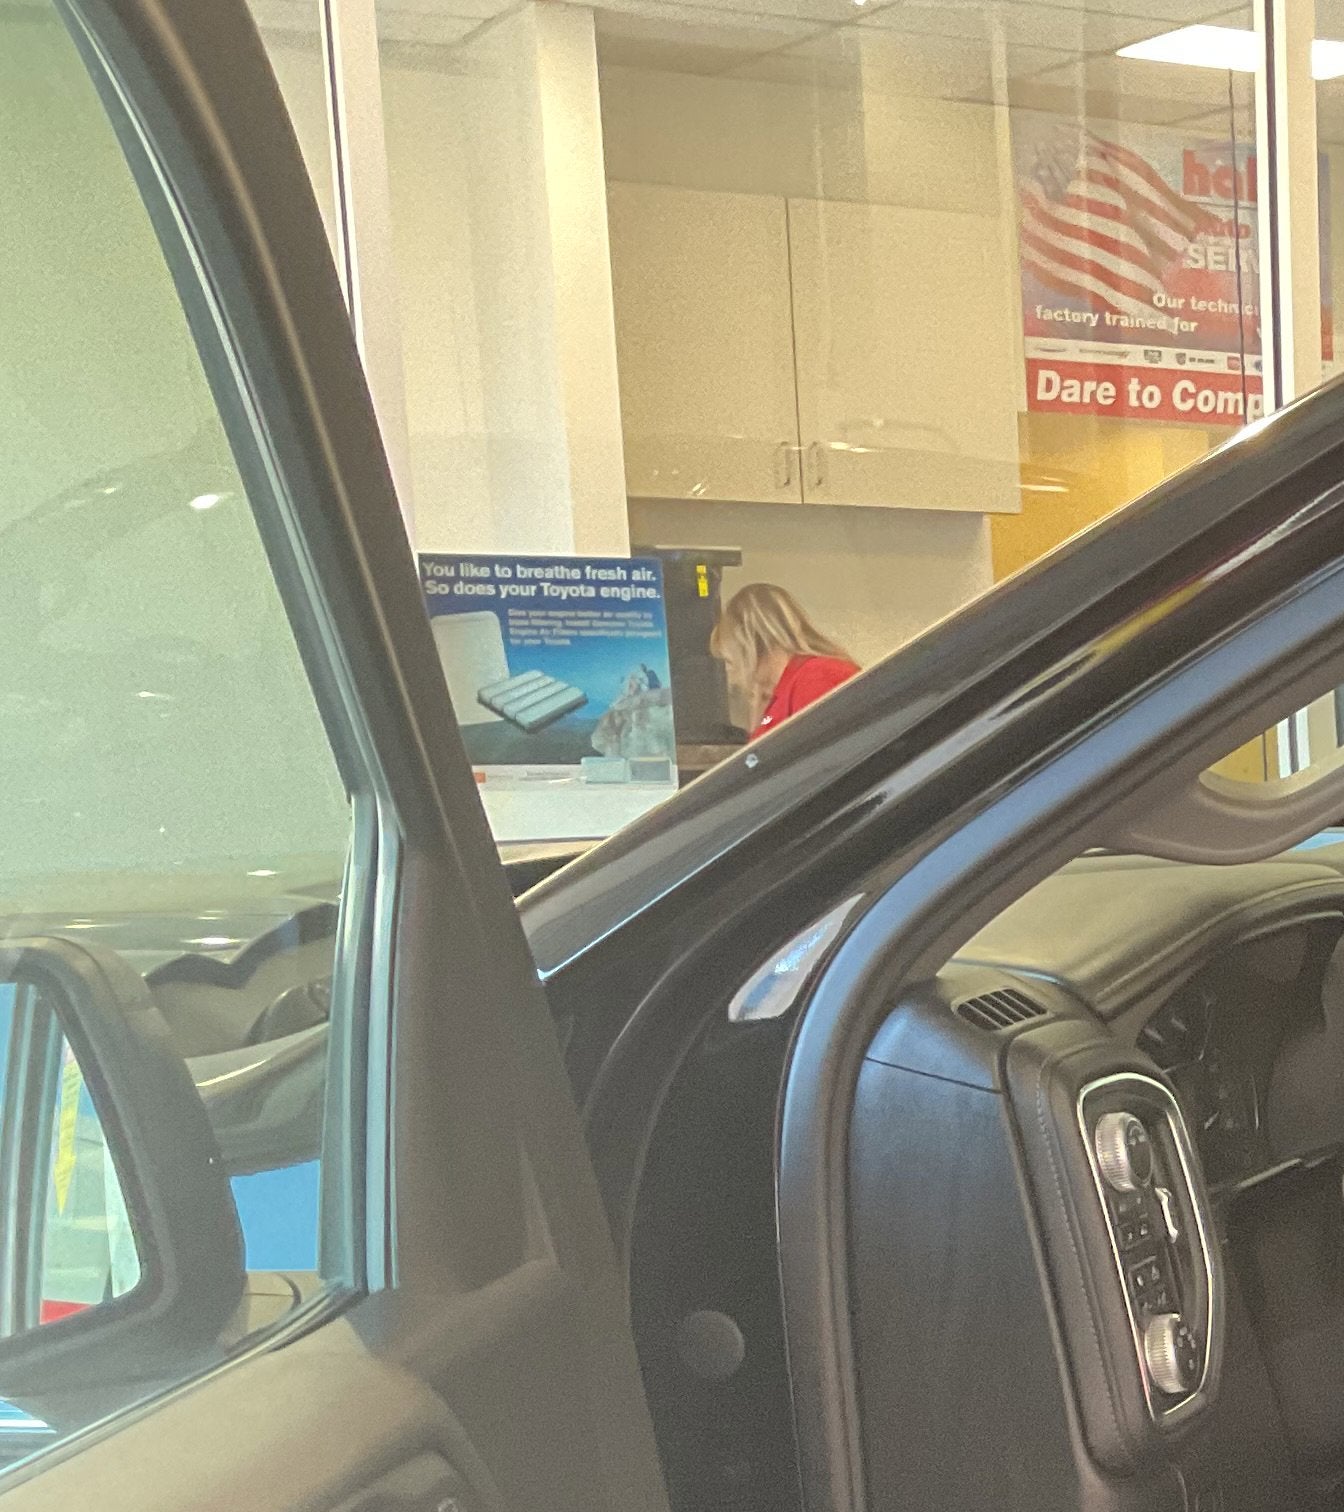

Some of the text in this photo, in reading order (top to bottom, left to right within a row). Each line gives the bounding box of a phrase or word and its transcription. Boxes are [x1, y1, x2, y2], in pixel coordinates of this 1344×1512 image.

[1152, 293, 1186, 309] Our
[1035, 304, 1099, 327] factory
[1105, 312, 1166, 331] trained
[1036, 369, 1117, 406] Dare
[1127, 377, 1162, 409] to
[422, 562, 657, 582] You like to breathe fresh air.
[425, 581, 661, 602] So does your Toyota engine.
